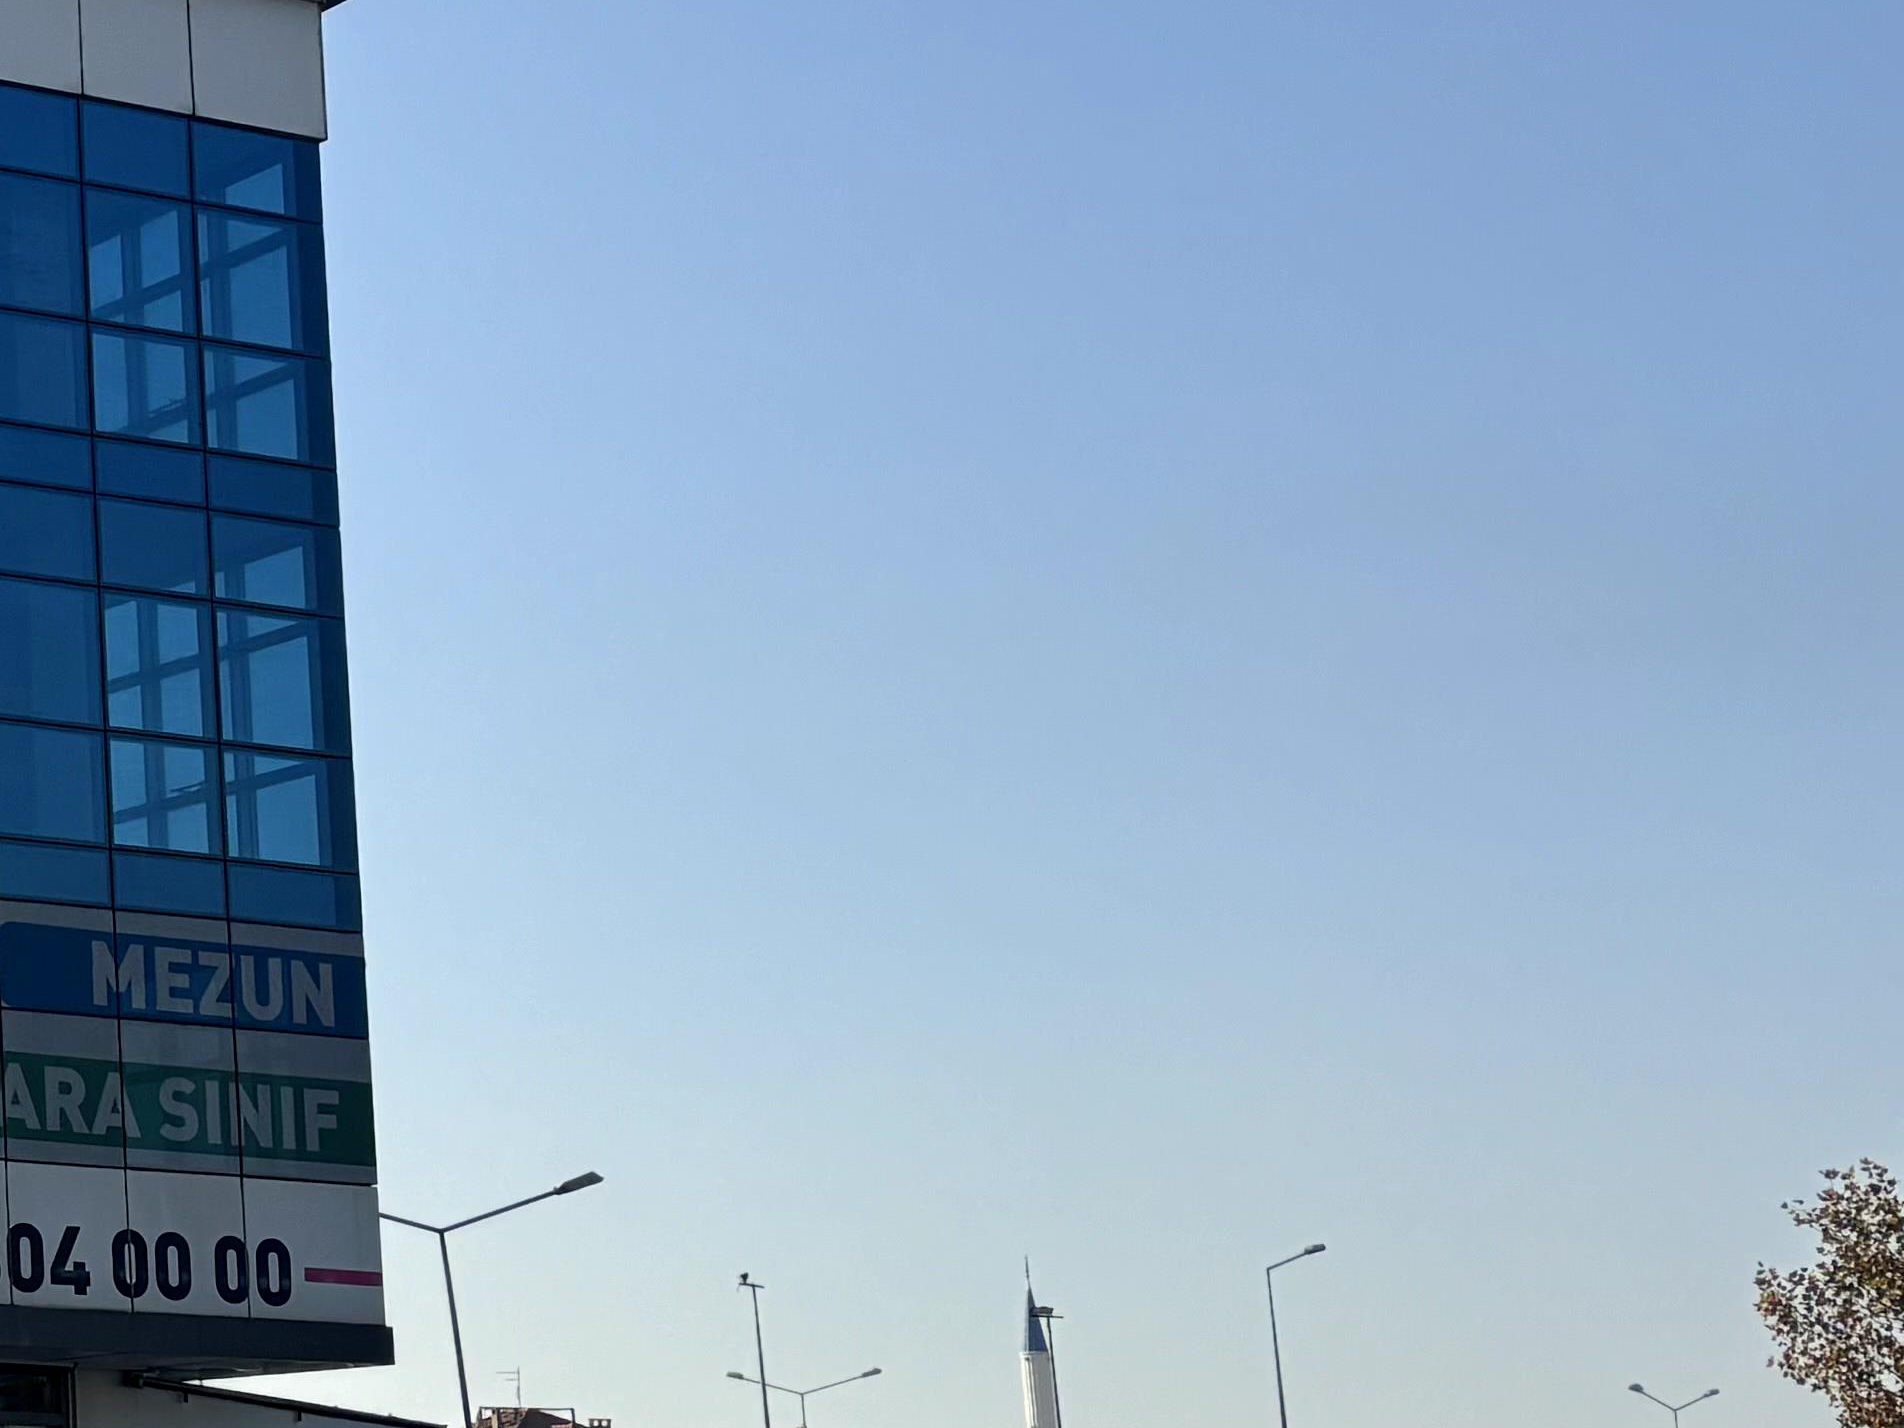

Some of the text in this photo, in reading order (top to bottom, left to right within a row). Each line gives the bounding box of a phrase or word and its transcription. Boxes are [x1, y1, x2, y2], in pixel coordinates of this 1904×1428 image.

[90, 941, 334, 1028] MEZUN
[159, 1077, 340, 1153] SINIF
[112, 1228, 191, 1302] 00
[215, 1235, 291, 1308] 00
